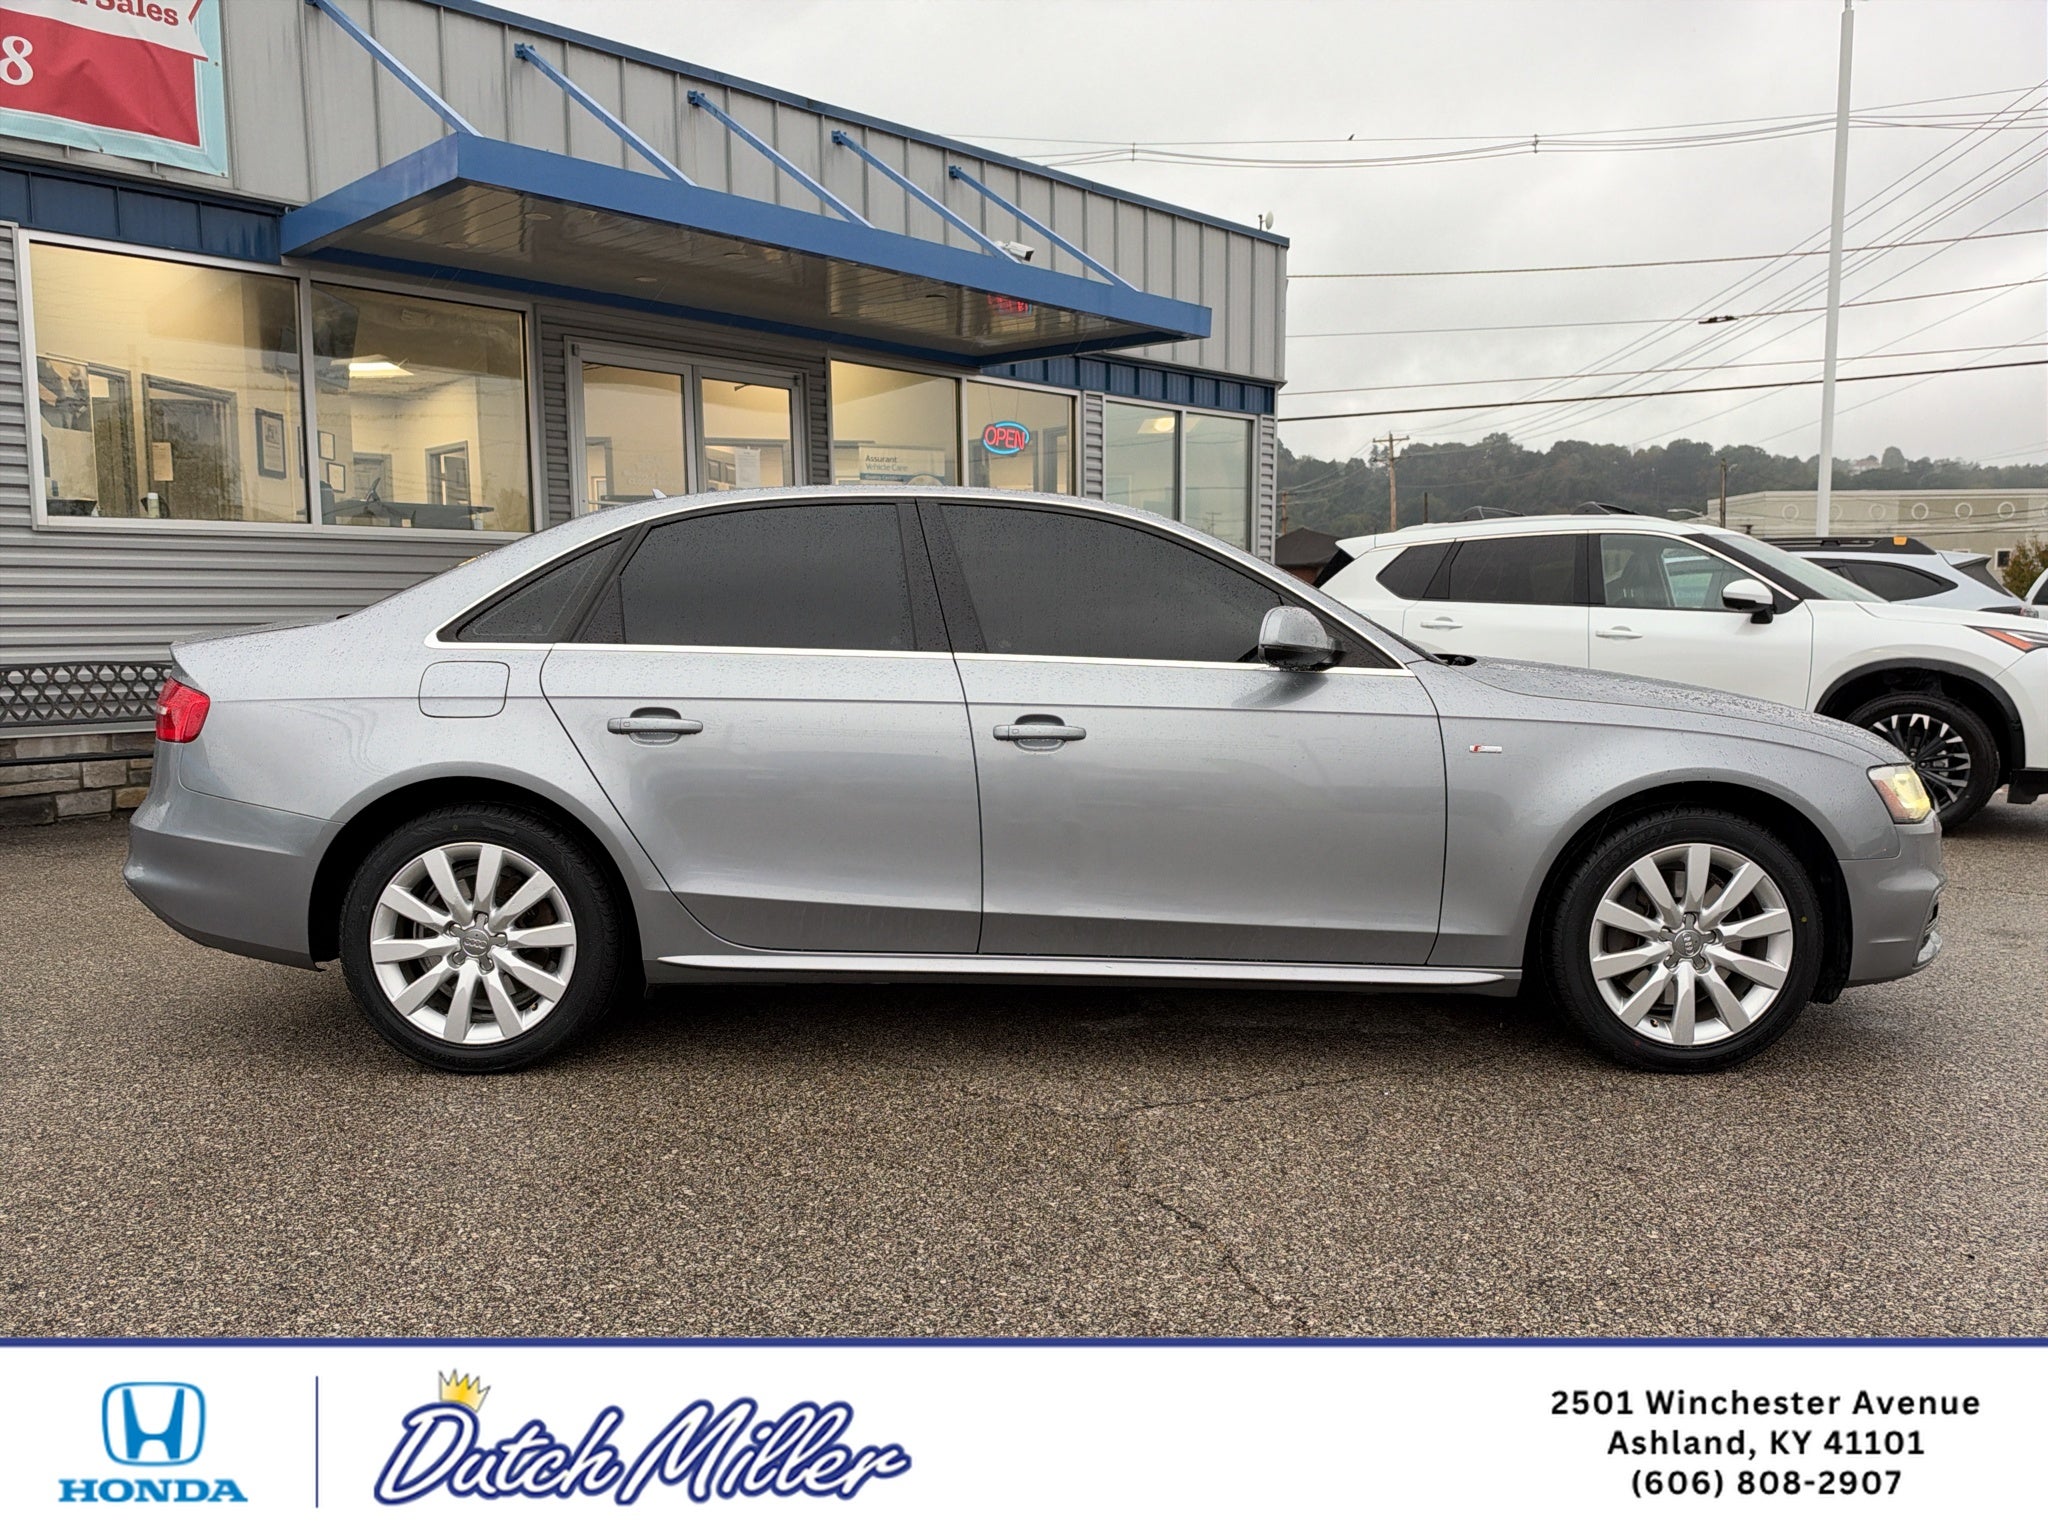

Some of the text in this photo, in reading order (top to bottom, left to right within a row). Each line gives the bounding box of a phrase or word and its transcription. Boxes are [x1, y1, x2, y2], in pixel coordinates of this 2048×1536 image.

[0, 35, 34, 86] 8
[984, 424, 1026, 450] OPEN
[865, 455, 898, 463] Assurant
